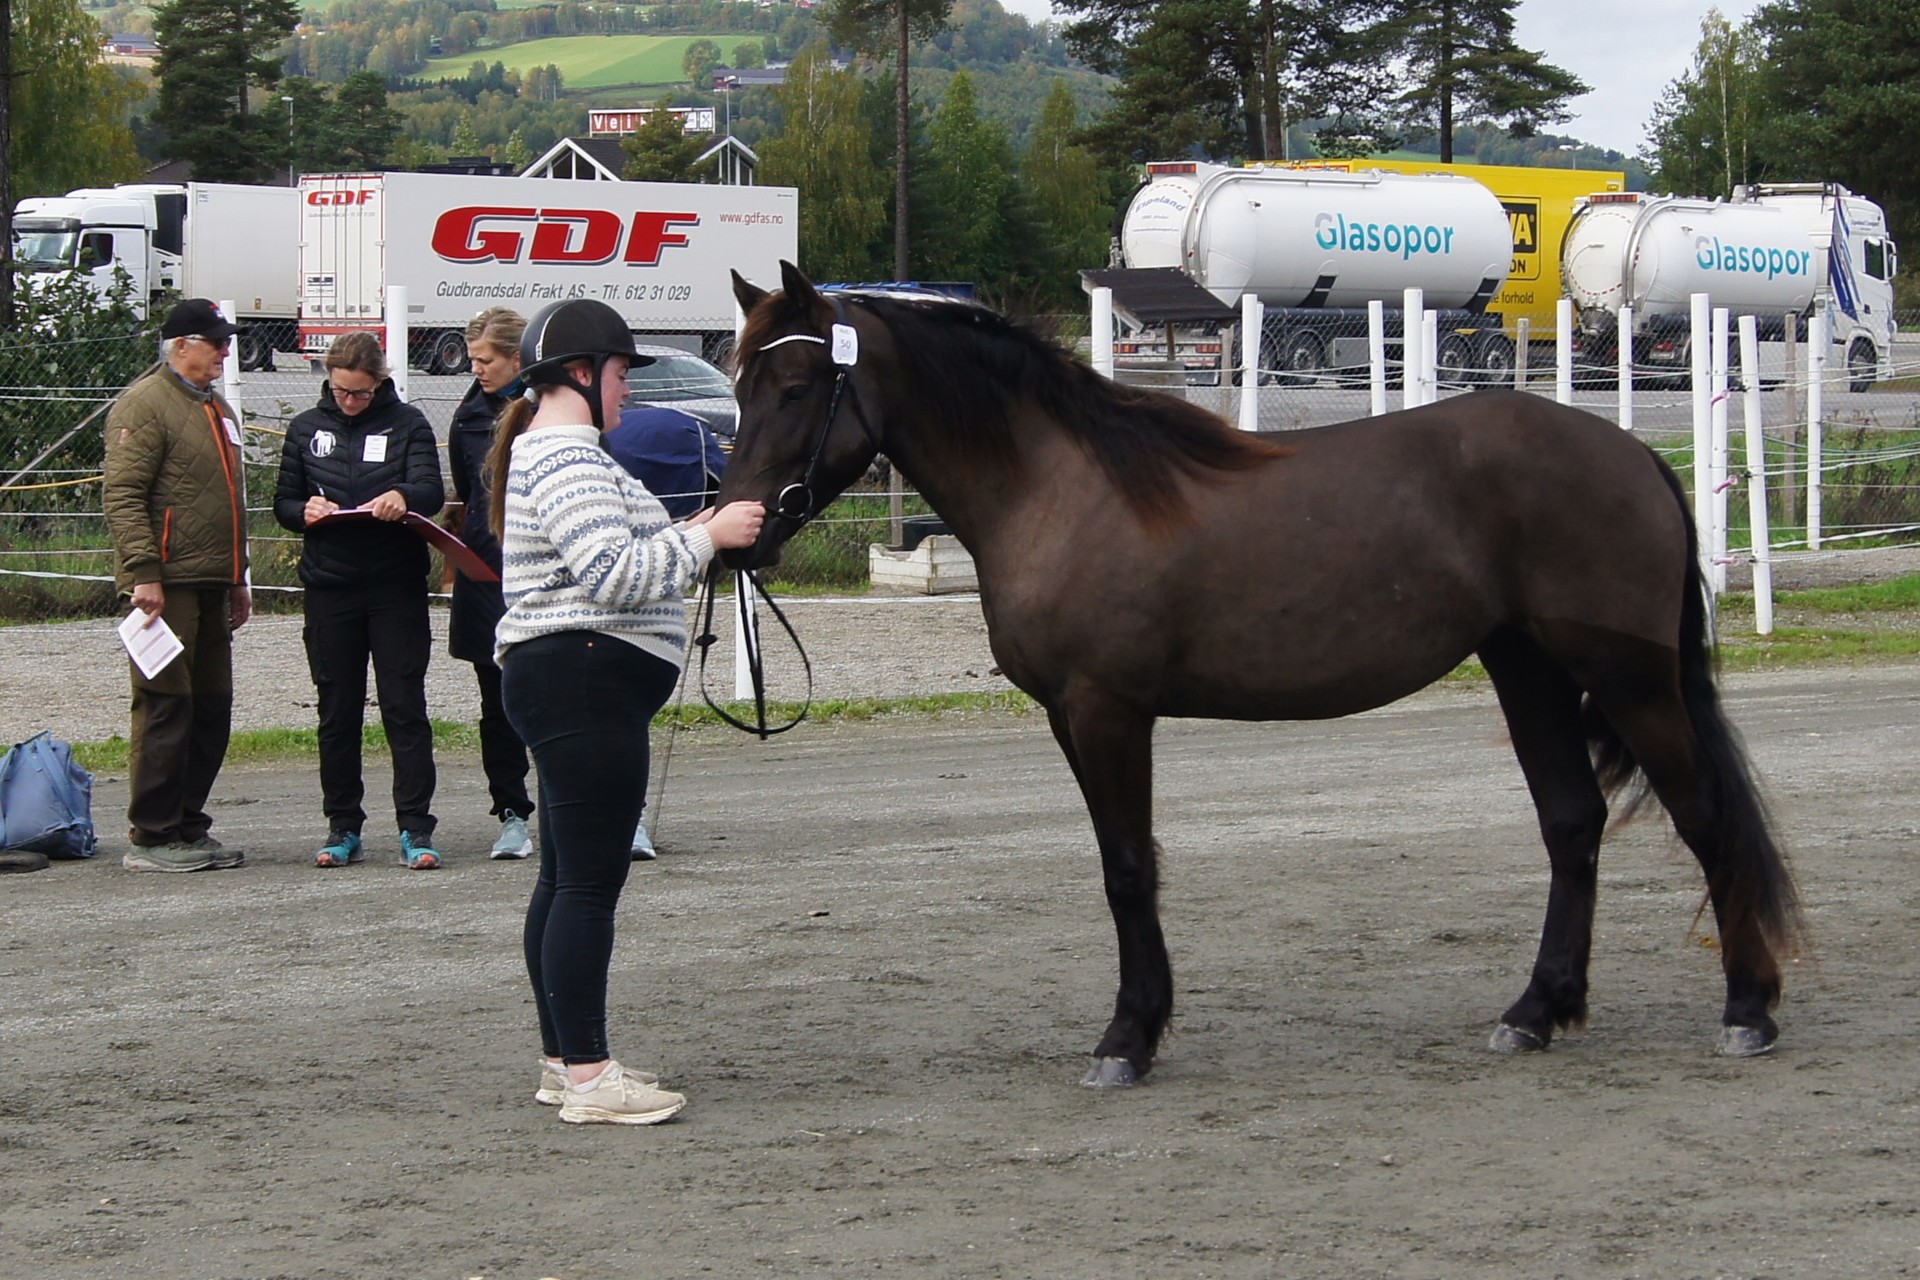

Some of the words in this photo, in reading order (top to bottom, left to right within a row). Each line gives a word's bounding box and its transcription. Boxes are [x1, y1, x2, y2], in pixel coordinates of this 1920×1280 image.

[307, 190, 376, 206] GDF
[719, 212, 783, 226] www.gdfas.no
[431, 206, 701, 267] GDF
[1314, 212, 1454, 261] Glasopor
[1695, 235, 1810, 281] Glasopor
[436, 281, 527, 298] Gudbrandsdal
[530, 283, 563, 299] Frakt
[567, 284, 586, 299] AS
[625, 285, 647, 300] 612
[650, 285, 665, 300] 31
[667, 285, 691, 301] 029
[1502, 291, 1534, 304] forhold
[840, 339, 851, 349] 50
